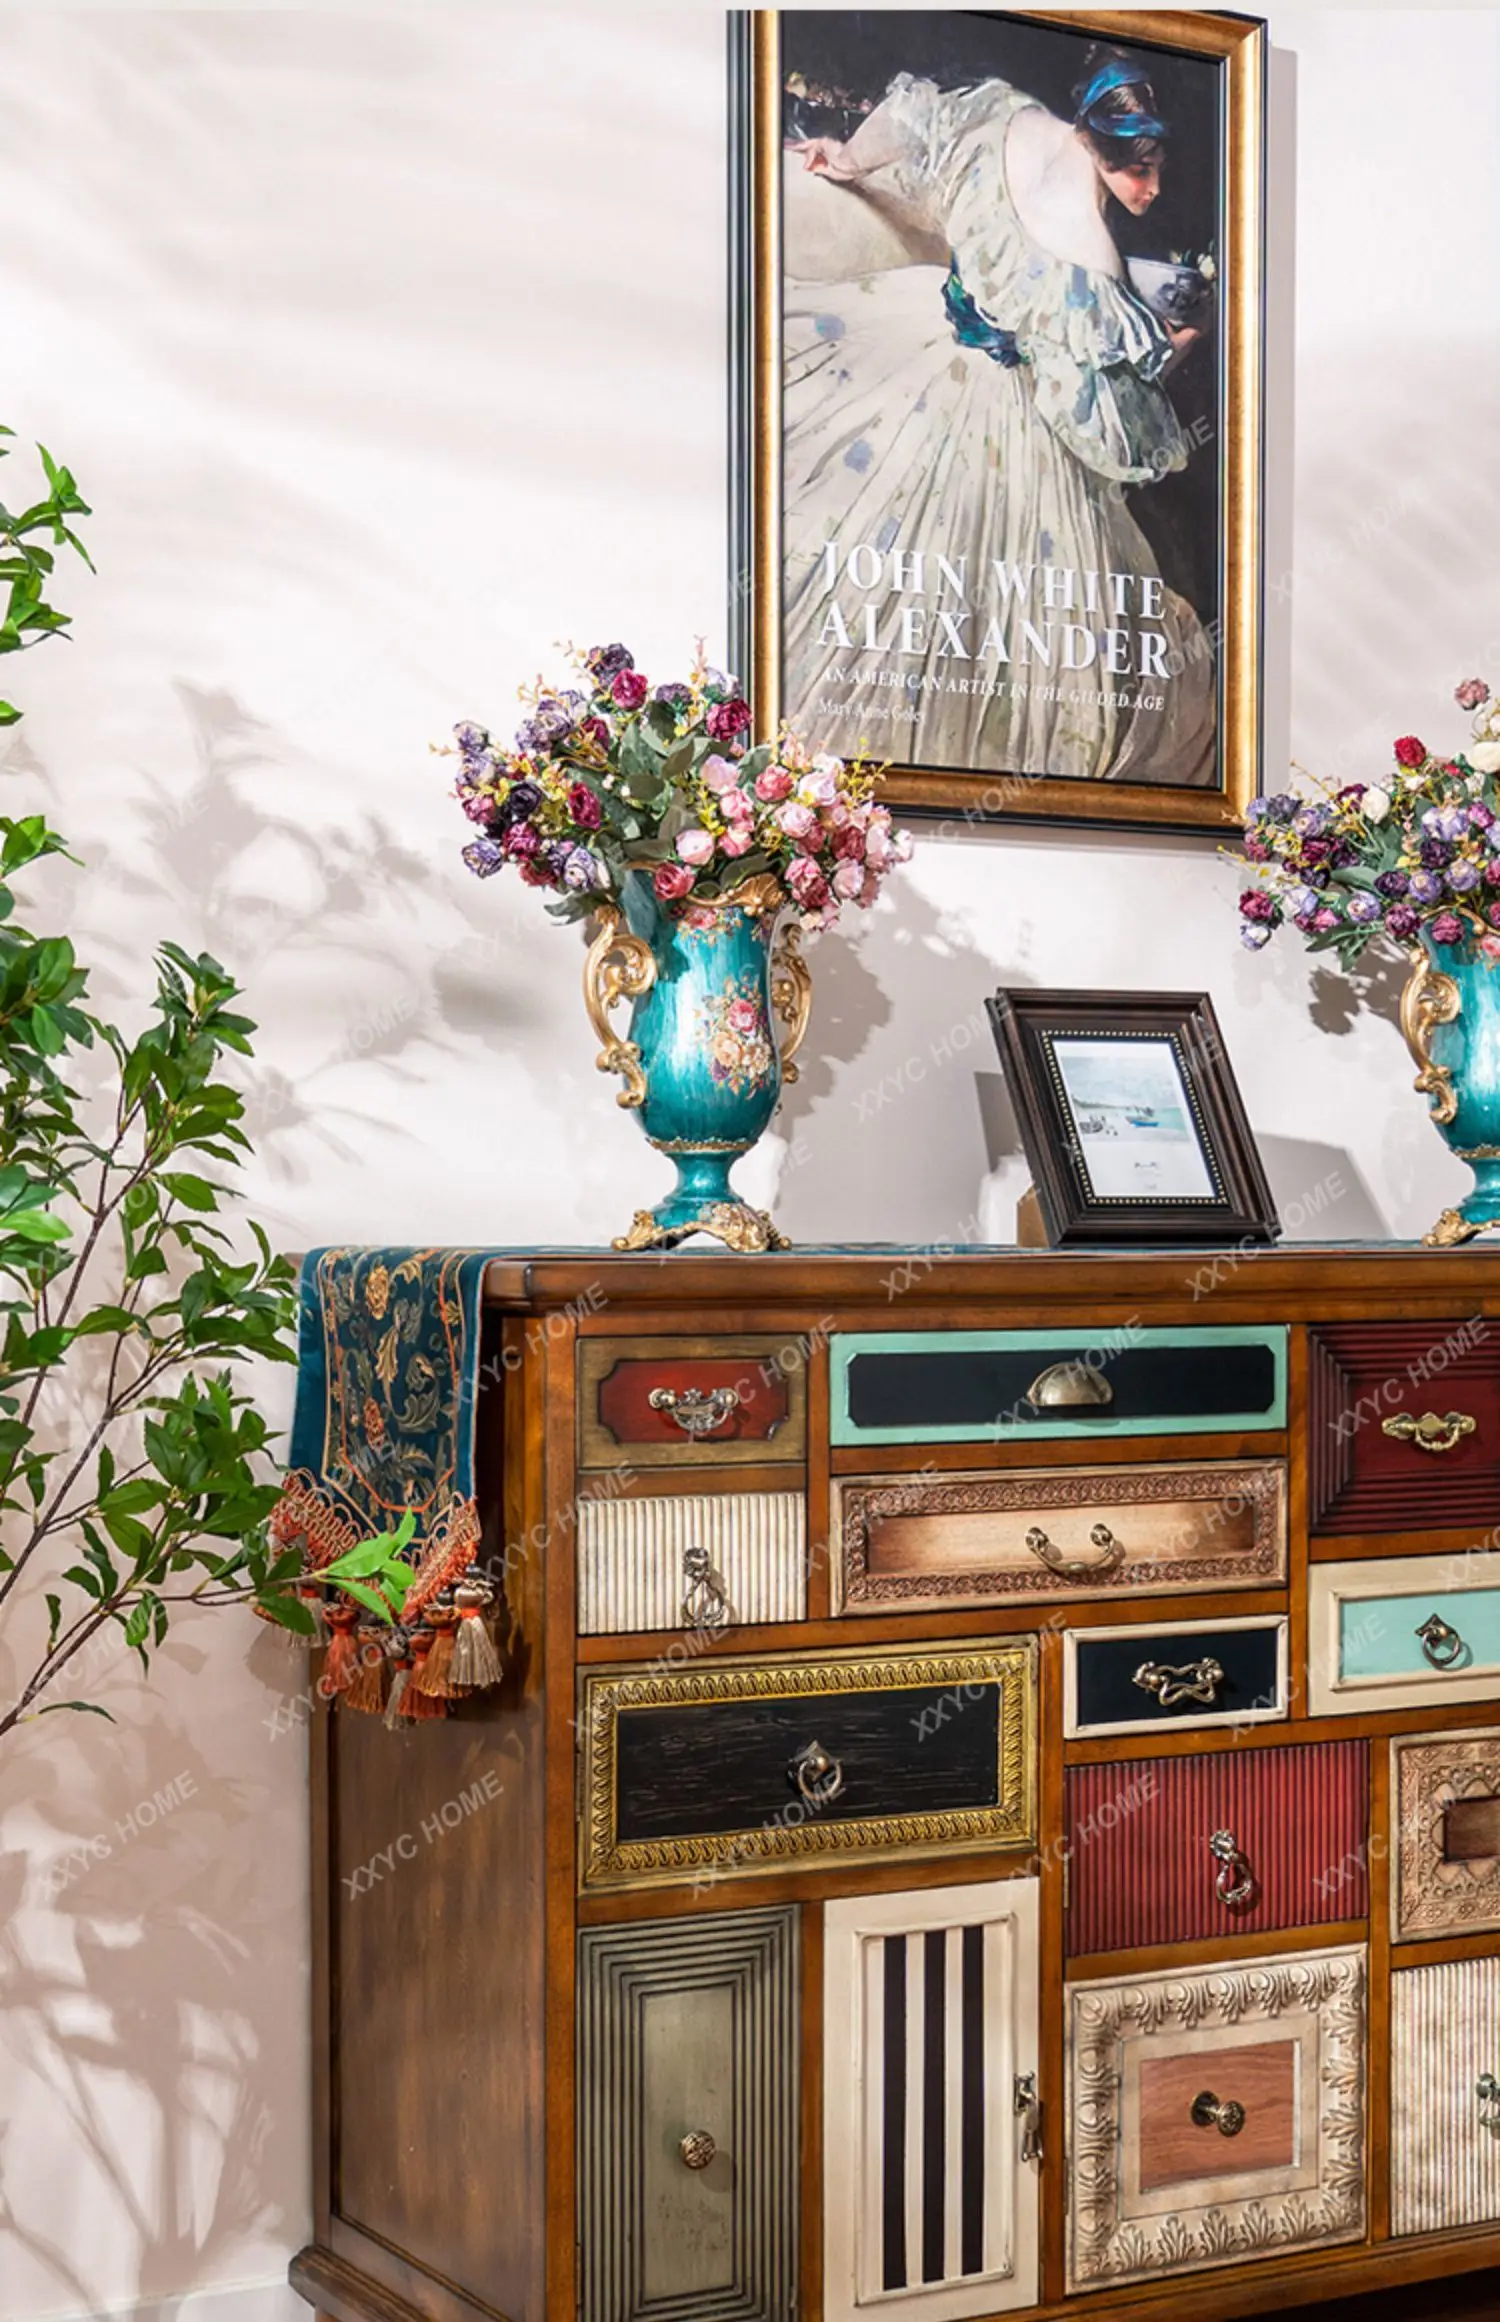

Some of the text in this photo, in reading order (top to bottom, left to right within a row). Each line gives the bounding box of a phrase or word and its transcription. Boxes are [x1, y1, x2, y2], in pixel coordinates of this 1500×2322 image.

[822, 541, 1166, 620] JOHN WHITE
[817, 598, 1171, 679] ALEXANDER
[822, 667, 847, 682] AN
[850, 669, 942, 691] AMERICAN
[946, 677, 1006, 697] ARTIST
[1011, 682, 1028, 699] IN
[1034, 685, 1065, 702] THE
[1131, 691, 1166, 712] AGE
